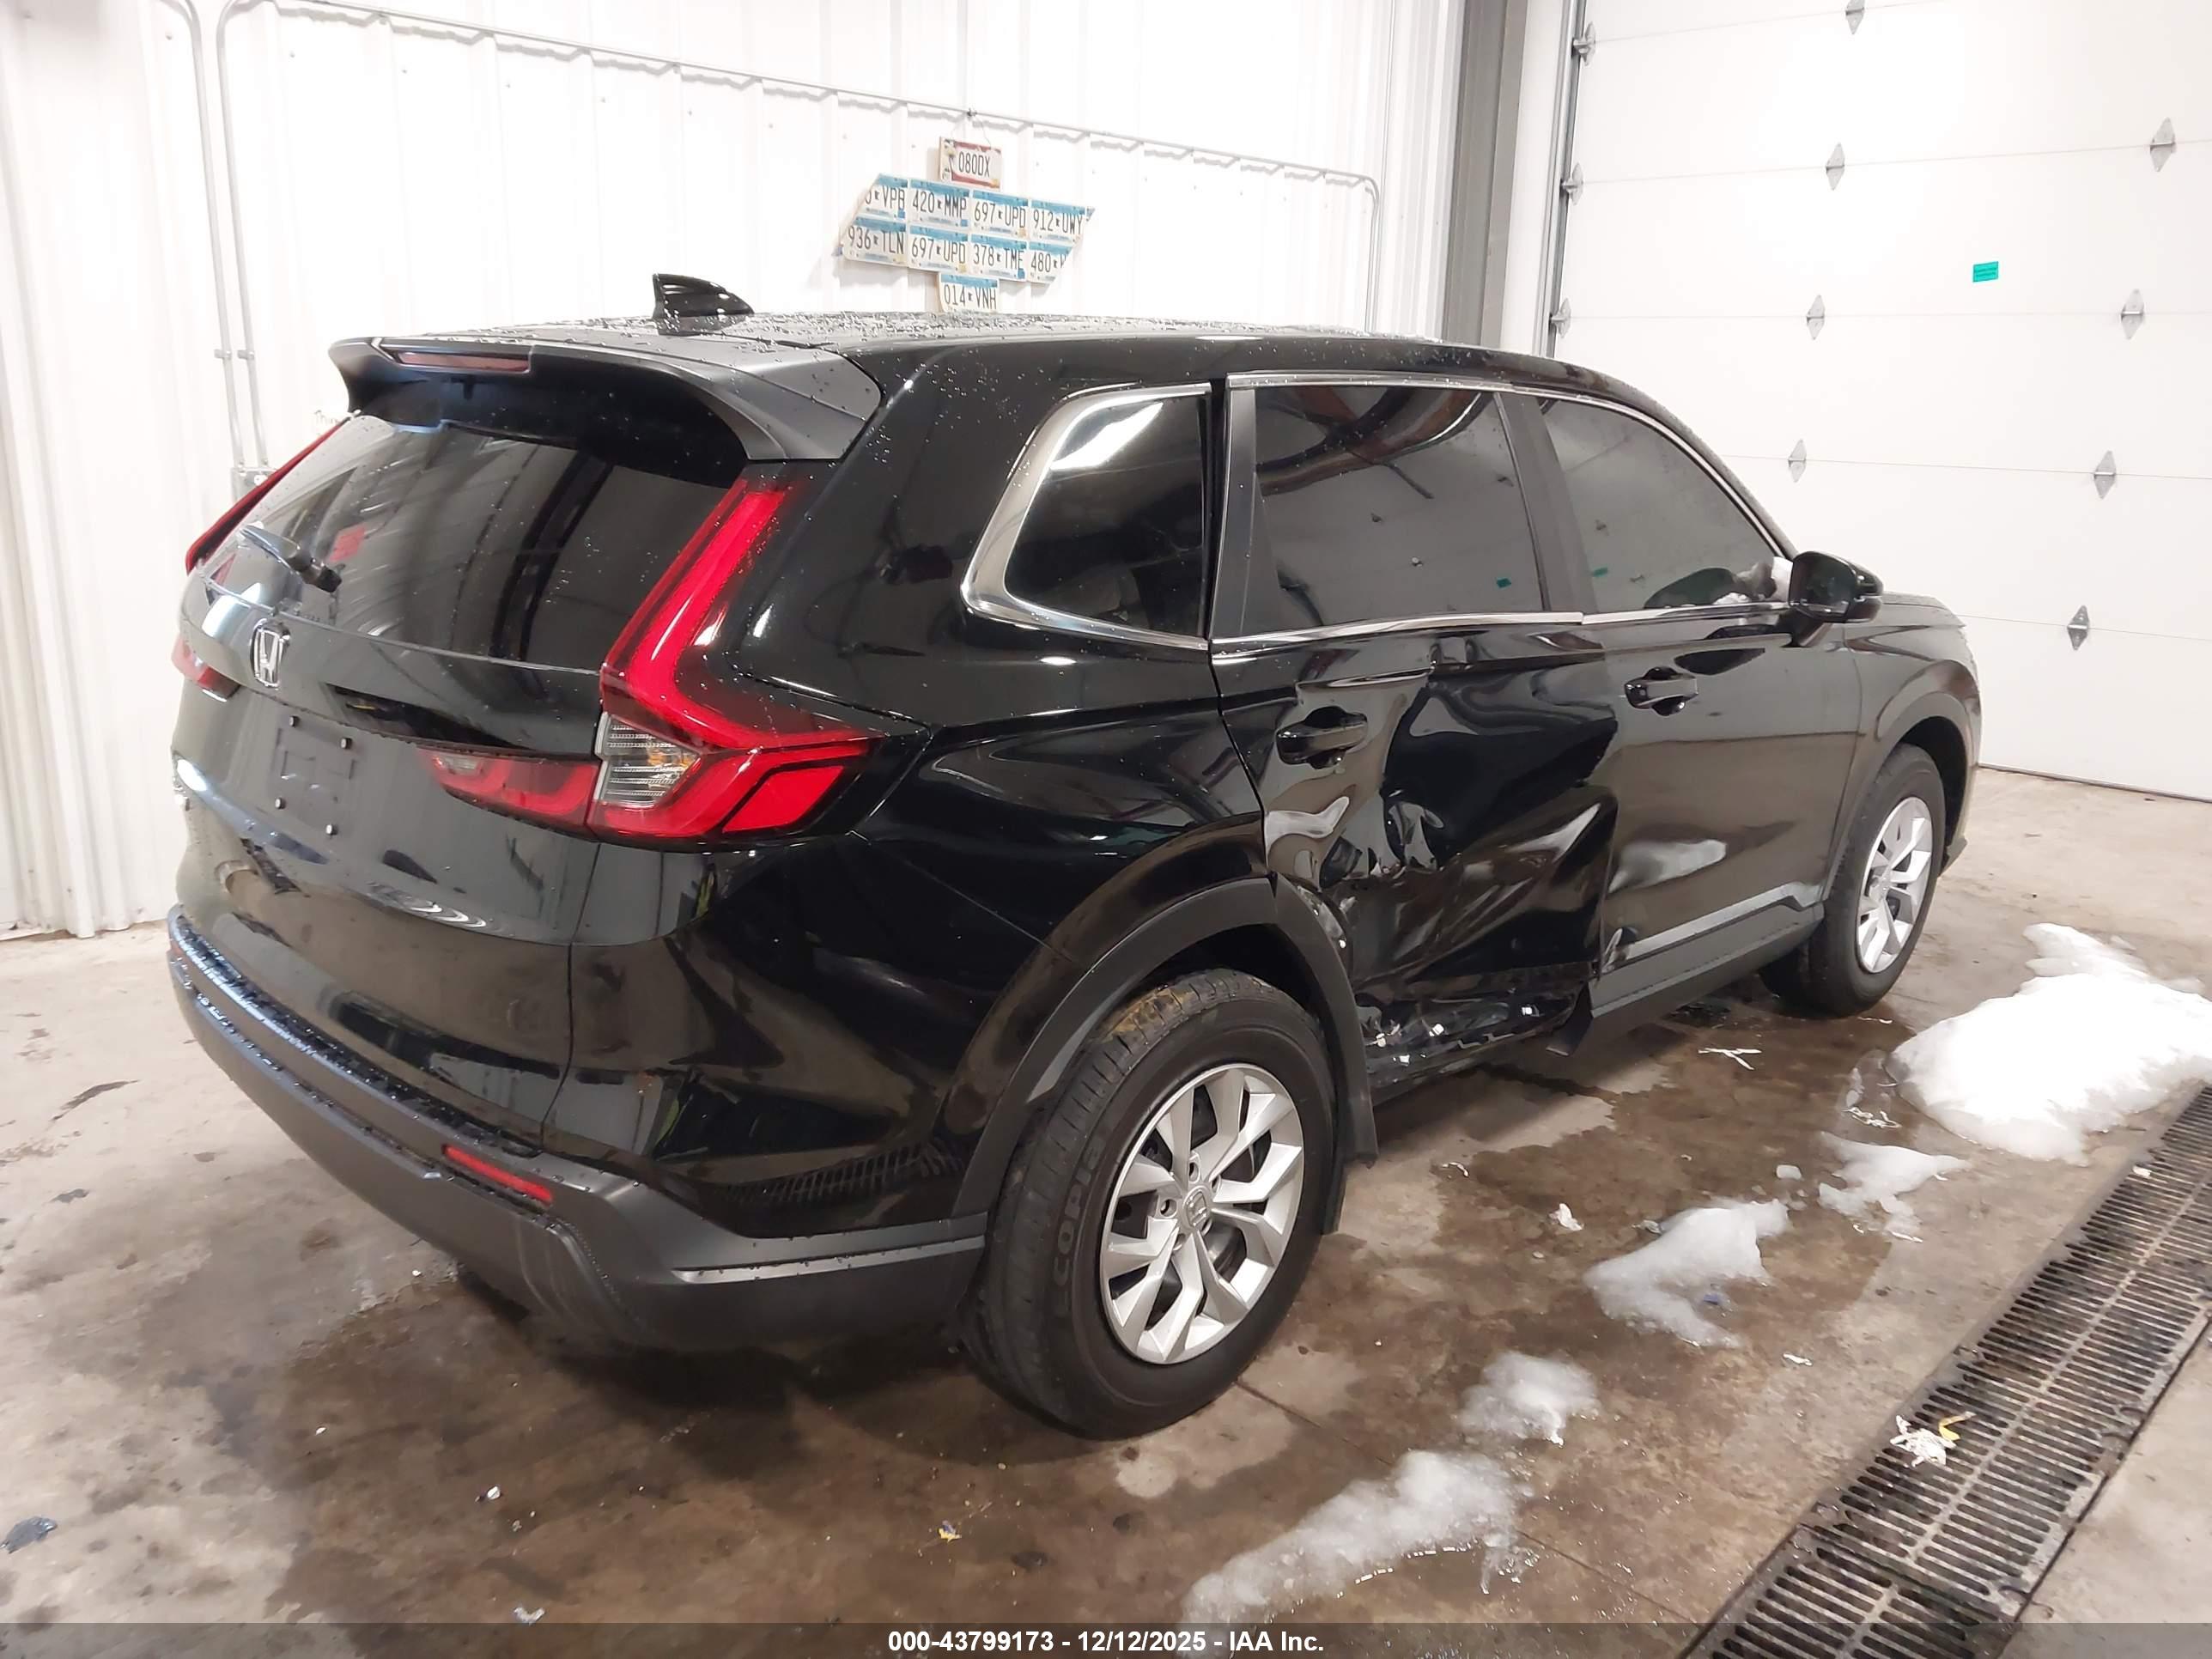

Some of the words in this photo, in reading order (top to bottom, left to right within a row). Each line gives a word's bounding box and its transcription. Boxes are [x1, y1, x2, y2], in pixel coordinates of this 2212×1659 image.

[913, 190, 934, 213] 420
[945, 193, 967, 218] MMP
[975, 202, 995, 223] 697
[1033, 209, 1054, 231] 912
[848, 226, 871, 250] 936
[912, 237, 934, 259] 697
[973, 244, 994, 266] 378
[1031, 252, 1051, 273] 480
[945, 284, 965, 307] 014
